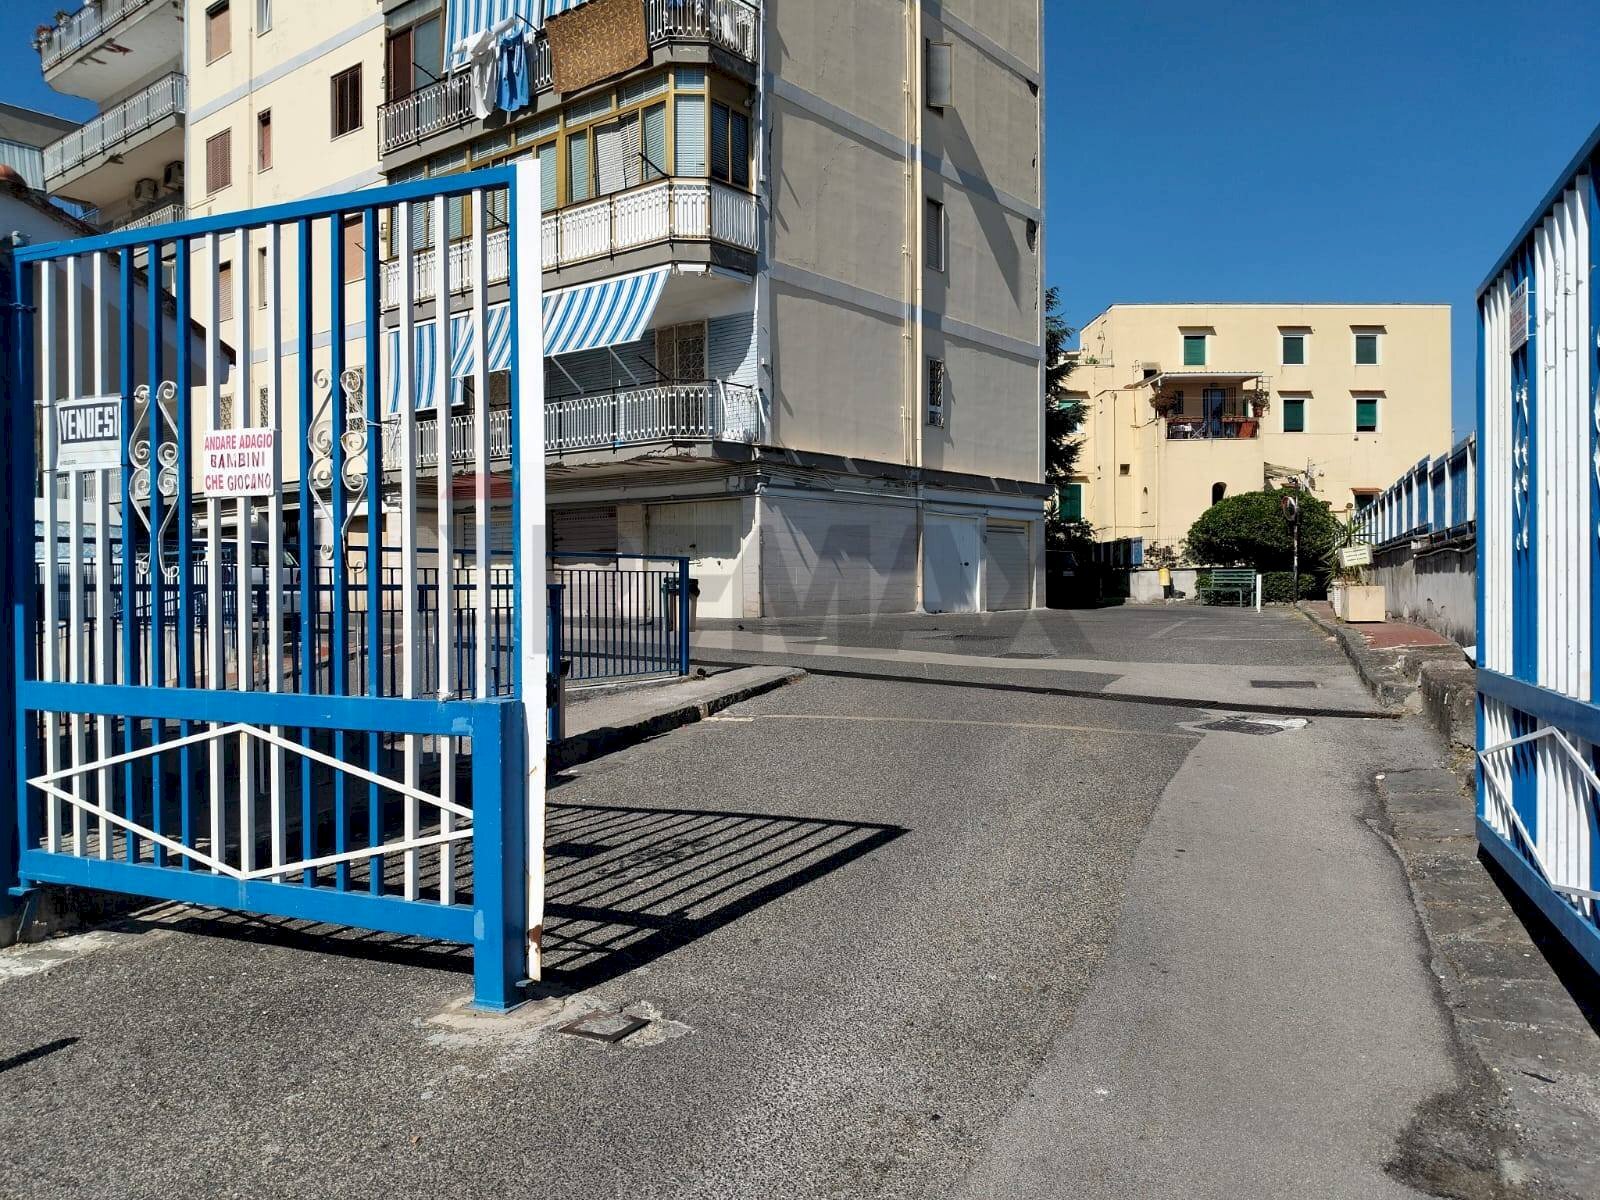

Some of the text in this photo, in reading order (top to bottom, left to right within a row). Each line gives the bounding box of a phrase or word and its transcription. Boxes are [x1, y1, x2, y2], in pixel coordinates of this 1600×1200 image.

[60, 406, 118, 441] VENDESI
[205, 433, 273, 450] ANDARE ADAGIO
[210, 451, 265, 469] BAMBINI
[205, 472, 272, 491] CHE GIOCANO
